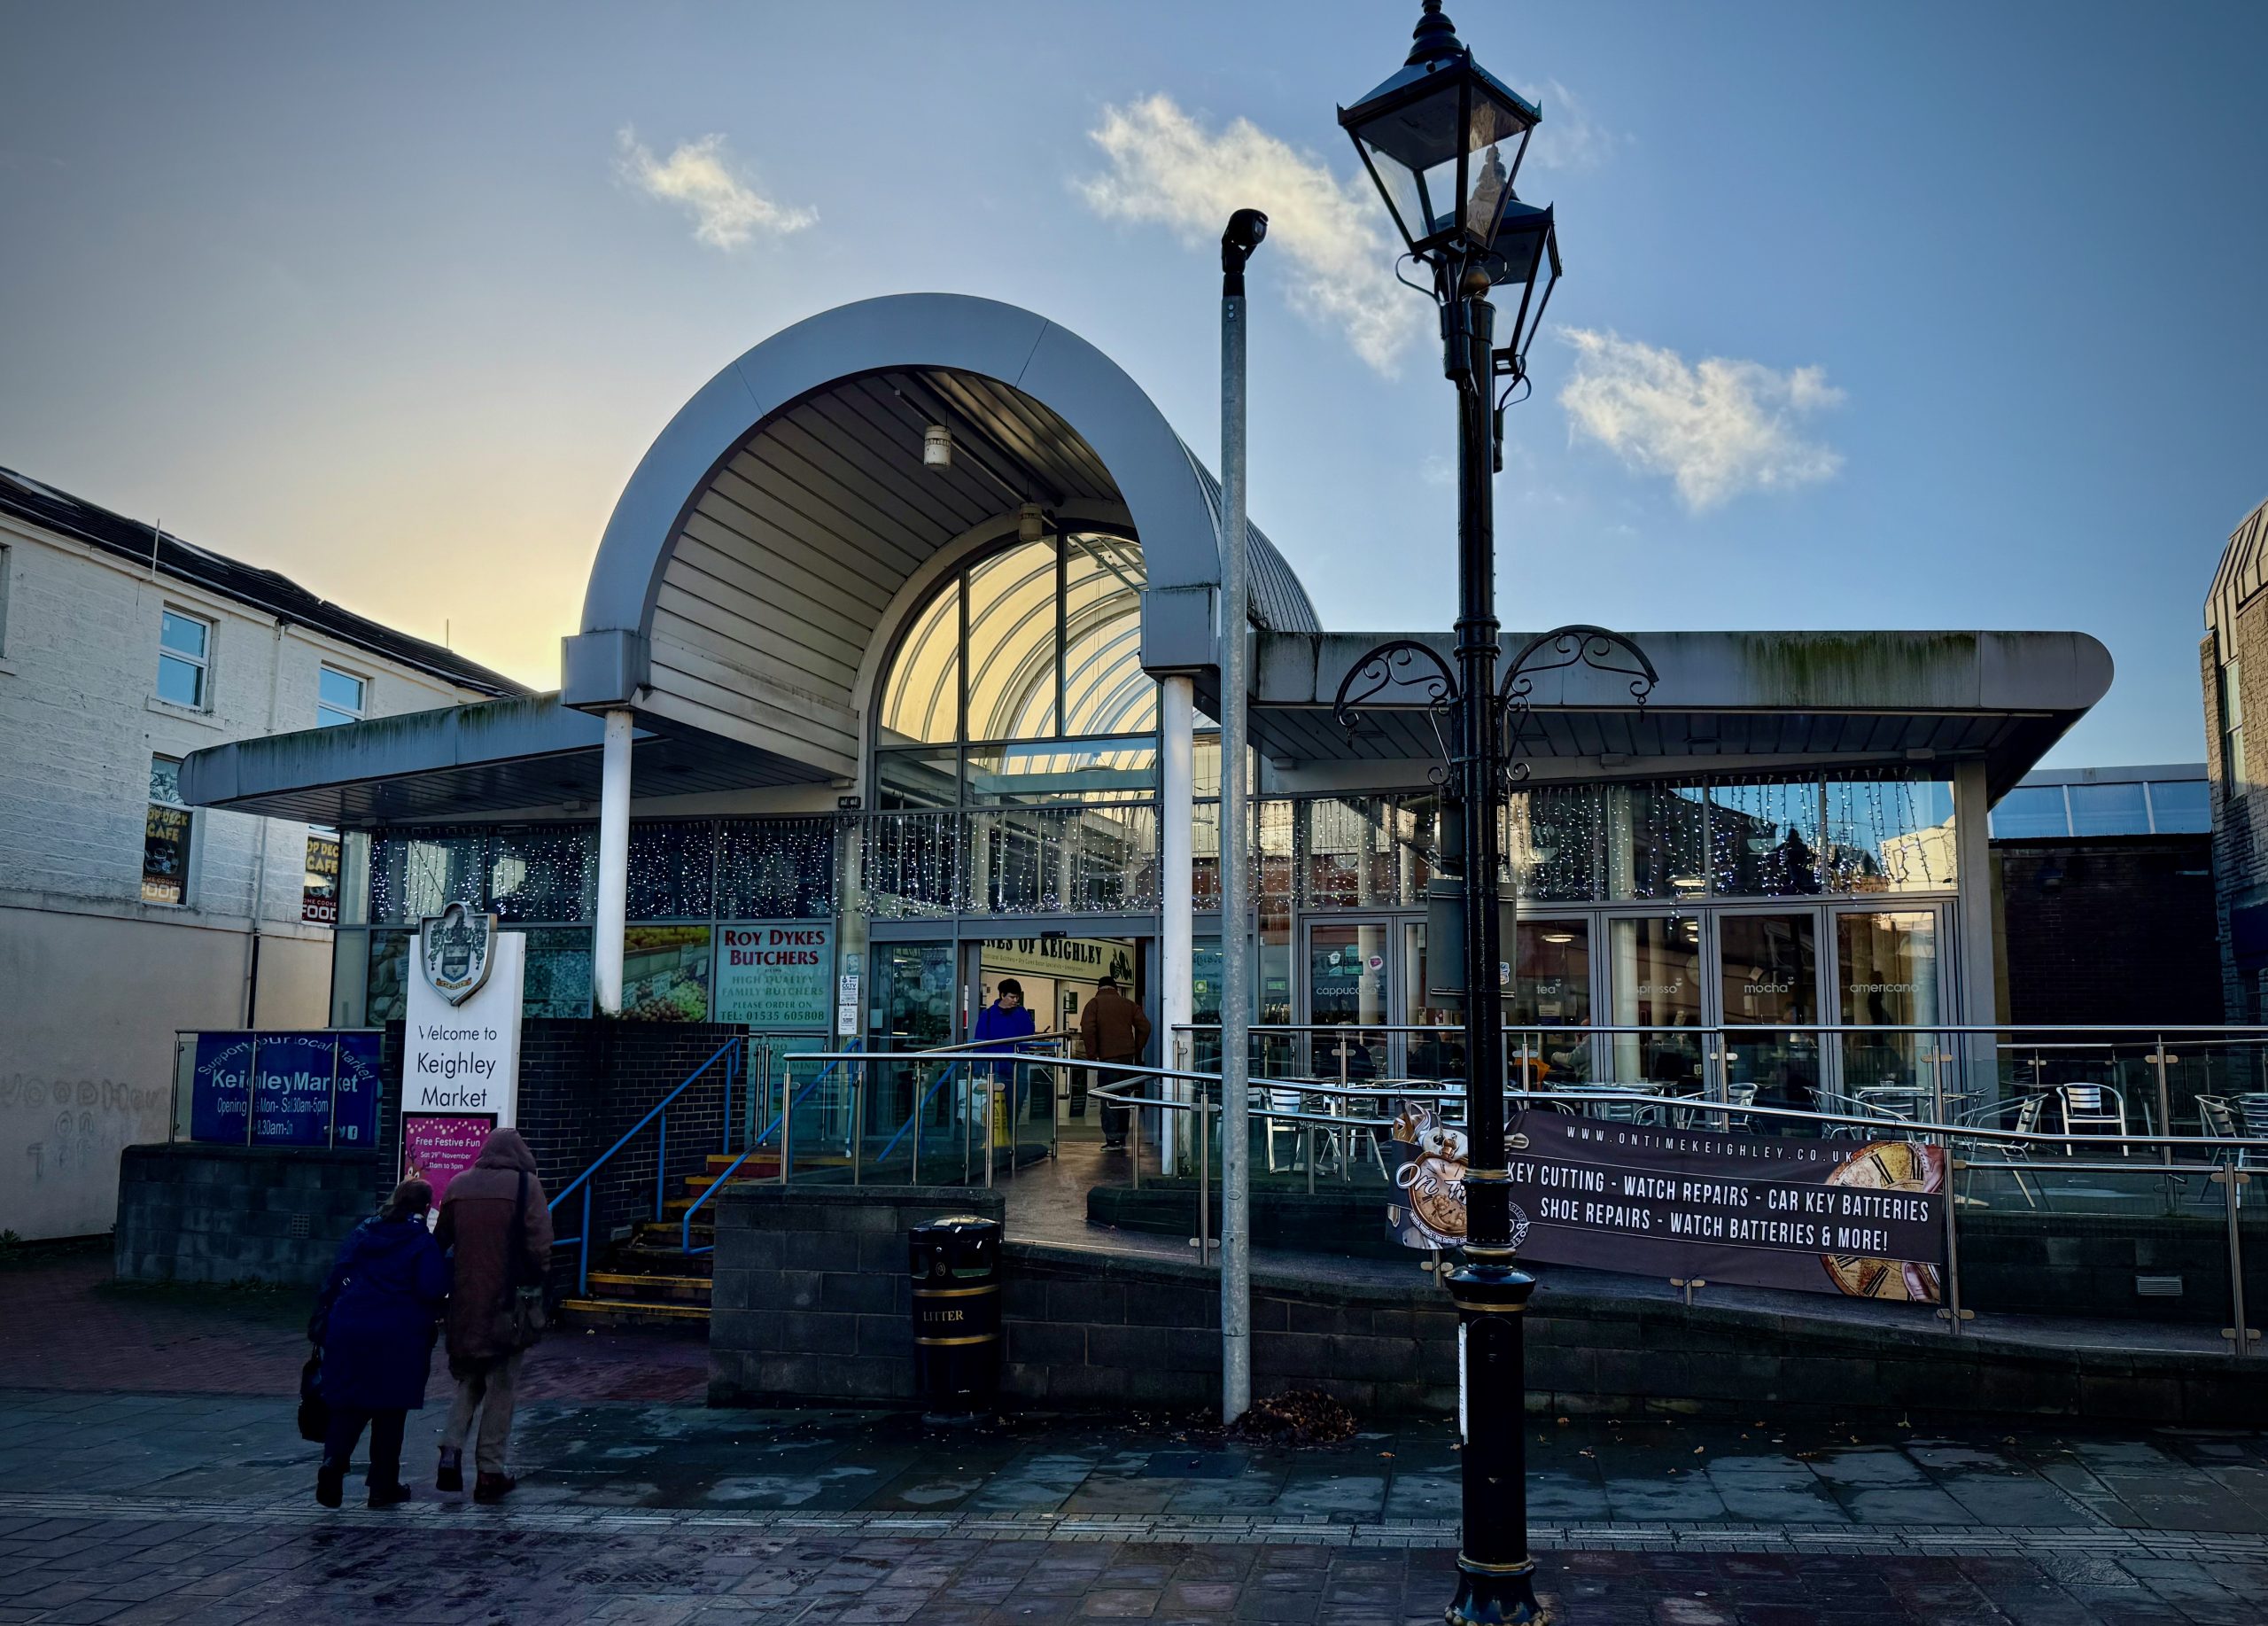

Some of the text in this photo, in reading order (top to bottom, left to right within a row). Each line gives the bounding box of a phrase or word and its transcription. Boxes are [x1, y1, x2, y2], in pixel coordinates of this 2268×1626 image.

[147, 823, 179, 843] CAFE
[321, 844, 338, 858] DEC
[307, 855, 338, 875] CAFE
[725, 930, 825, 945] ROY DYKES
[730, 950, 819, 965] BUTCHERS
[1041, 939, 1102, 965] KEIGHLEY
[732, 975, 814, 985] HIGH QUALITY
[722, 986, 824, 997] FAMILY BUTCHERS
[1536, 984, 1556, 994] tea
[1744, 983, 1788, 993] mocha
[1850, 983, 1920, 993] americano
[720, 1010, 825, 1021] TEL: 01535 605808
[418, 1024, 497, 1040] Welcome to
[198, 1040, 250, 1076] Support
[417, 1051, 496, 1079] Keighley
[421, 1085, 487, 1107] Market
[217, 1097, 247, 1116] Opening
[416, 1136, 480, 1147] Free Festive Fun
[1396, 1161, 1440, 1195] On
[1507, 1161, 1535, 1184] KEY
[1540, 1165, 1605, 1193] CUTTING
[1624, 1175, 1676, 1201] WATCH
[1683, 1182, 1750, 1208] REPAIRS
[1768, 1188, 1799, 1212] CAR
[1805, 1191, 1837, 1214] KEY
[1842, 1194, 1930, 1222] BATTERIES
[1540, 1196, 1581, 1221] SHOE
[1585, 1202, 1651, 1230] REPAIRS
[1670, 1211, 1723, 1239] WATCH
[1729, 1218, 1815, 1246] BATTERIES
[1821, 1225, 1831, 1248] &
[1837, 1226, 1889, 1252] MORE!
[923, 1310, 964, 1322] LITTER
